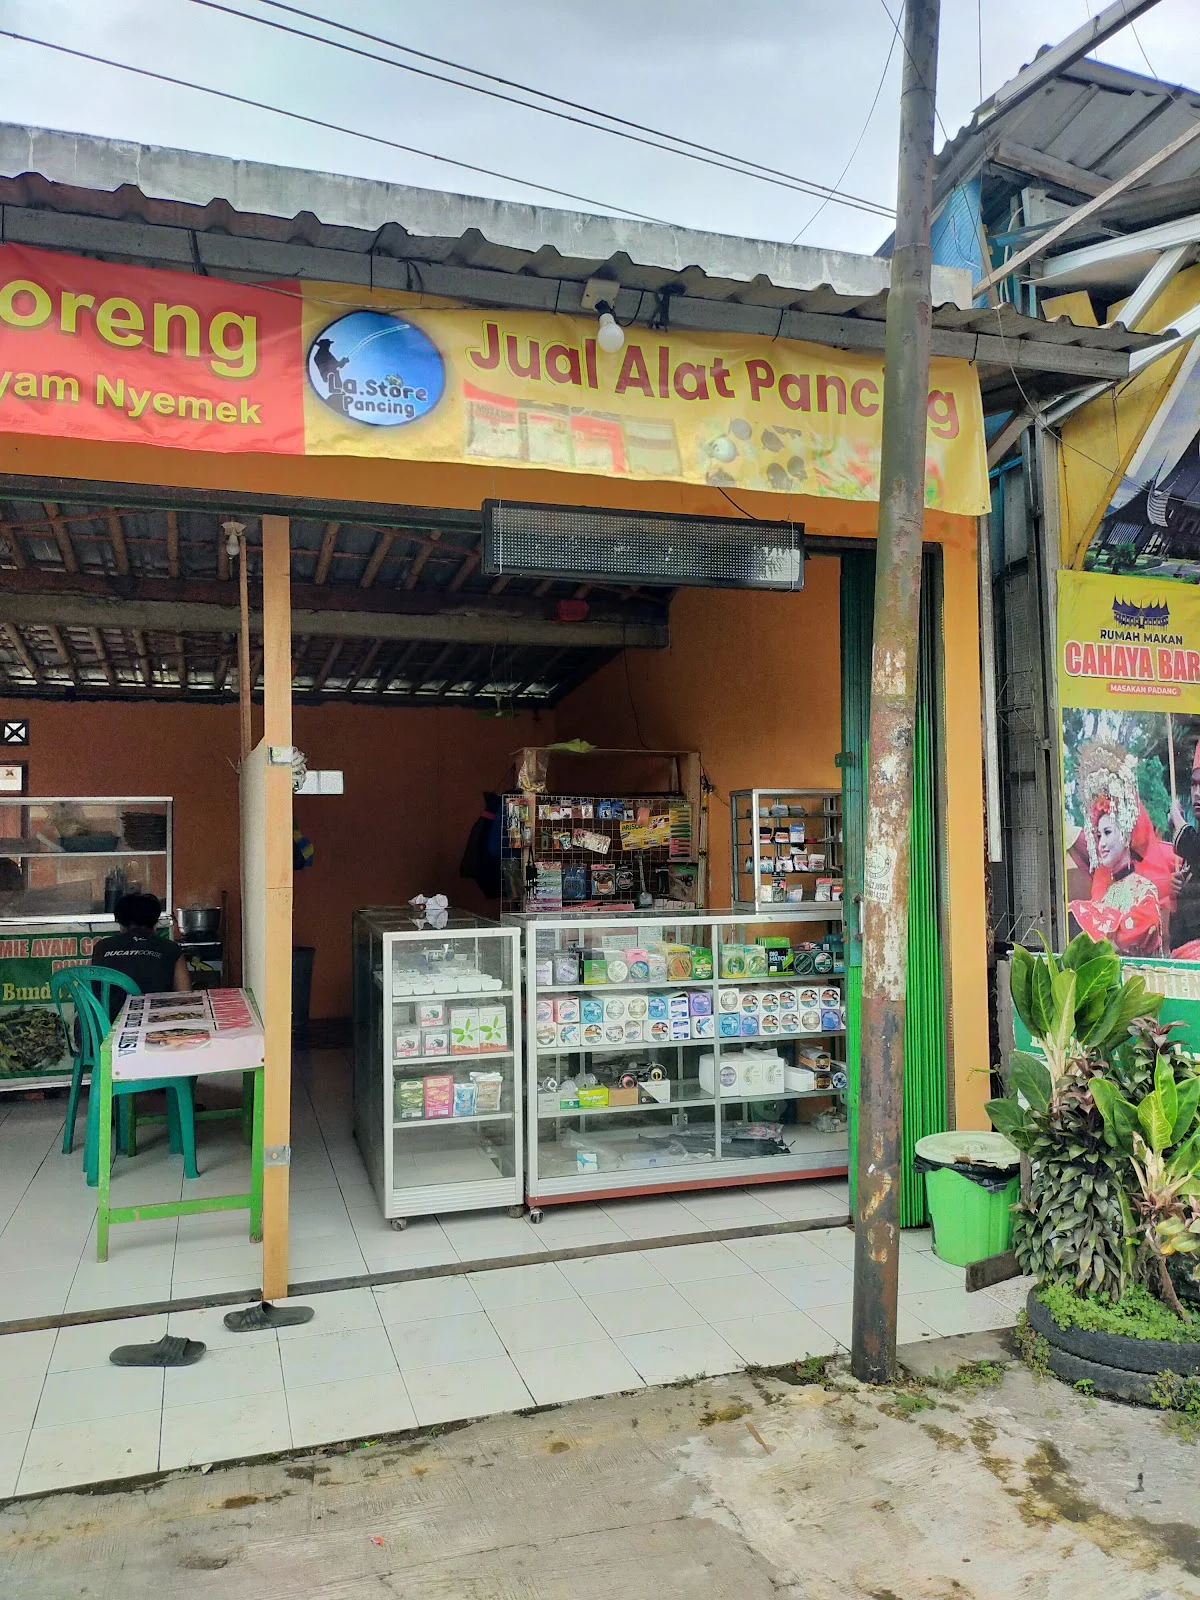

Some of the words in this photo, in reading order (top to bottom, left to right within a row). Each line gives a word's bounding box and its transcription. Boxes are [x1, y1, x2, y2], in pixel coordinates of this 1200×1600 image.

[0, 279, 258, 379] oreng
[469, 322, 599, 390] Jual
[615, 344, 736, 401] Alat
[746, 357, 960, 440] Pancg
[96, 373, 262, 425] Nyemek
[342, 394, 416, 419] Pancing
[1100, 629, 1140, 642] RUMAH
[1143, 633, 1183, 646] MAKAN
[1065, 641, 1155, 681] CAHAYA
[1110, 685, 1146, 695] MASAKAN
[1147, 686, 1177, 696] PADANG
[0, 939, 29, 958] MIE
[31, 937, 78, 958] AYAM
[2, 981, 62, 1001] Bund
